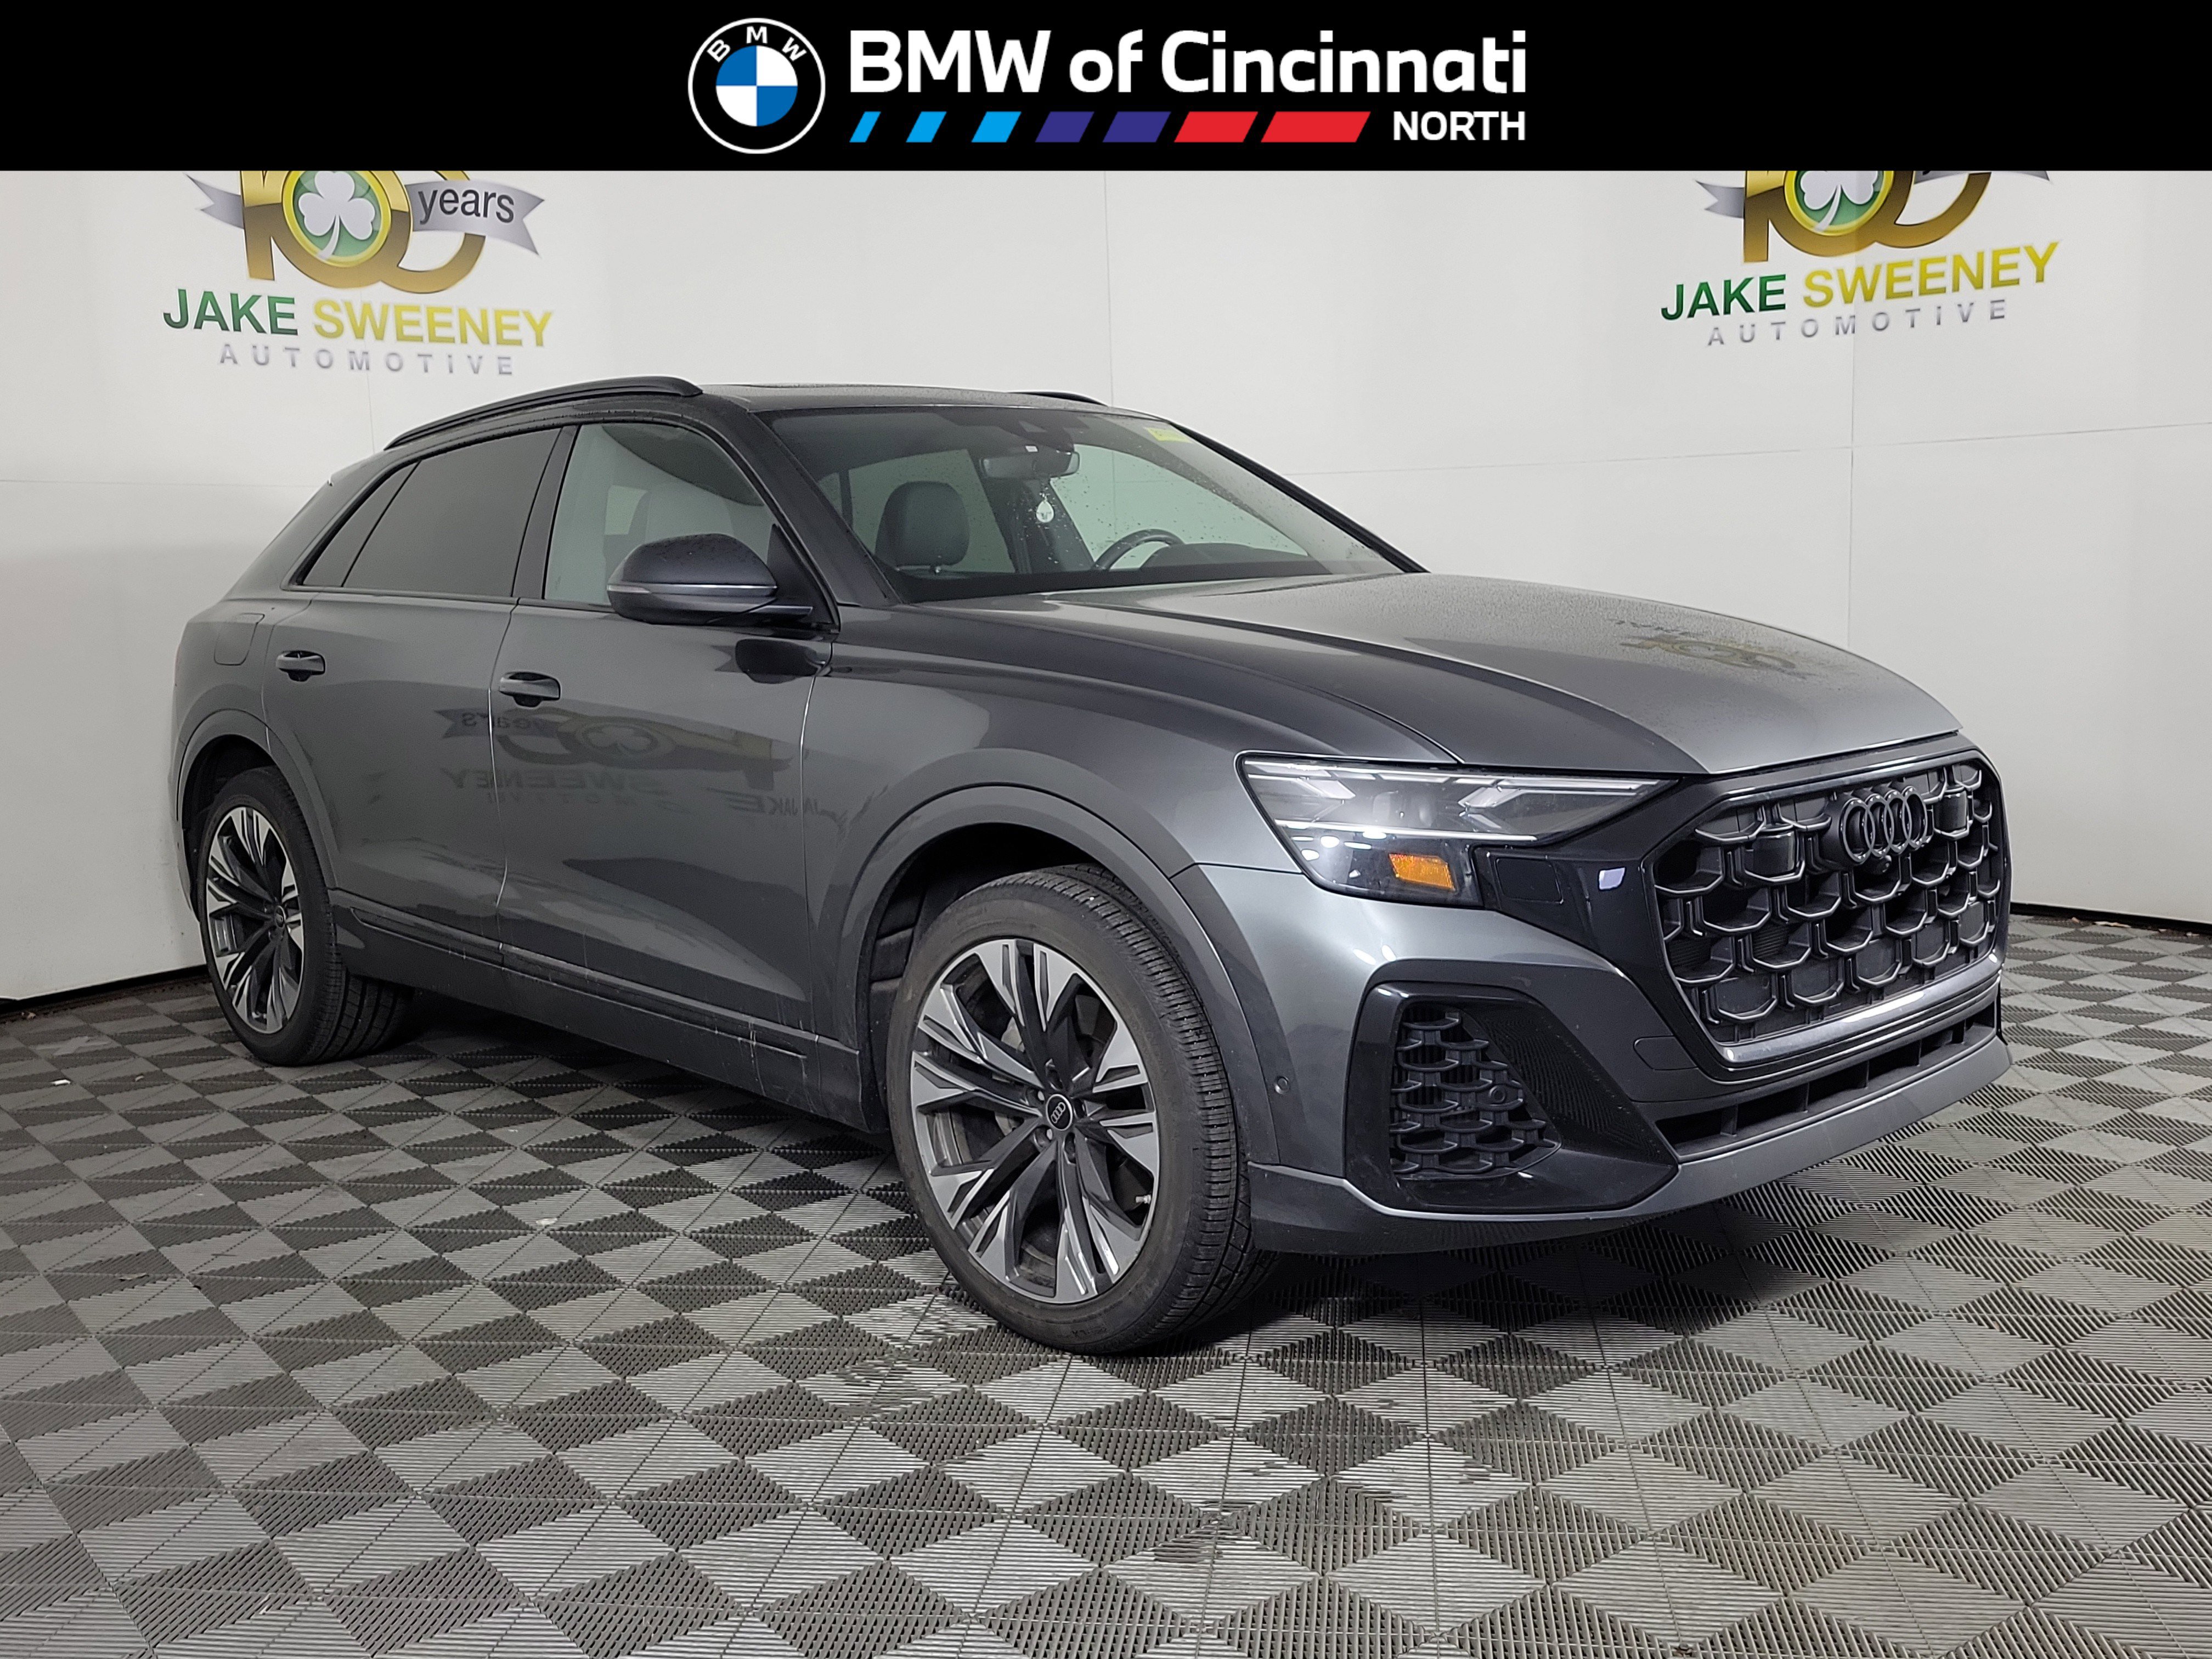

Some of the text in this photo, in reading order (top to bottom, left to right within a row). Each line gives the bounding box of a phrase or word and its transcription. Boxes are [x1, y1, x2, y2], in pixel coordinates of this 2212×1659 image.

[418, 189, 515, 225] years
[1661, 241, 2059, 320] JAKE SWEENEY
[163, 289, 552, 347] JAKE SWEENEY
[1708, 299, 2005, 346] AUTOMOTIVE
[220, 343, 512, 375] AUTOMOTIVE
